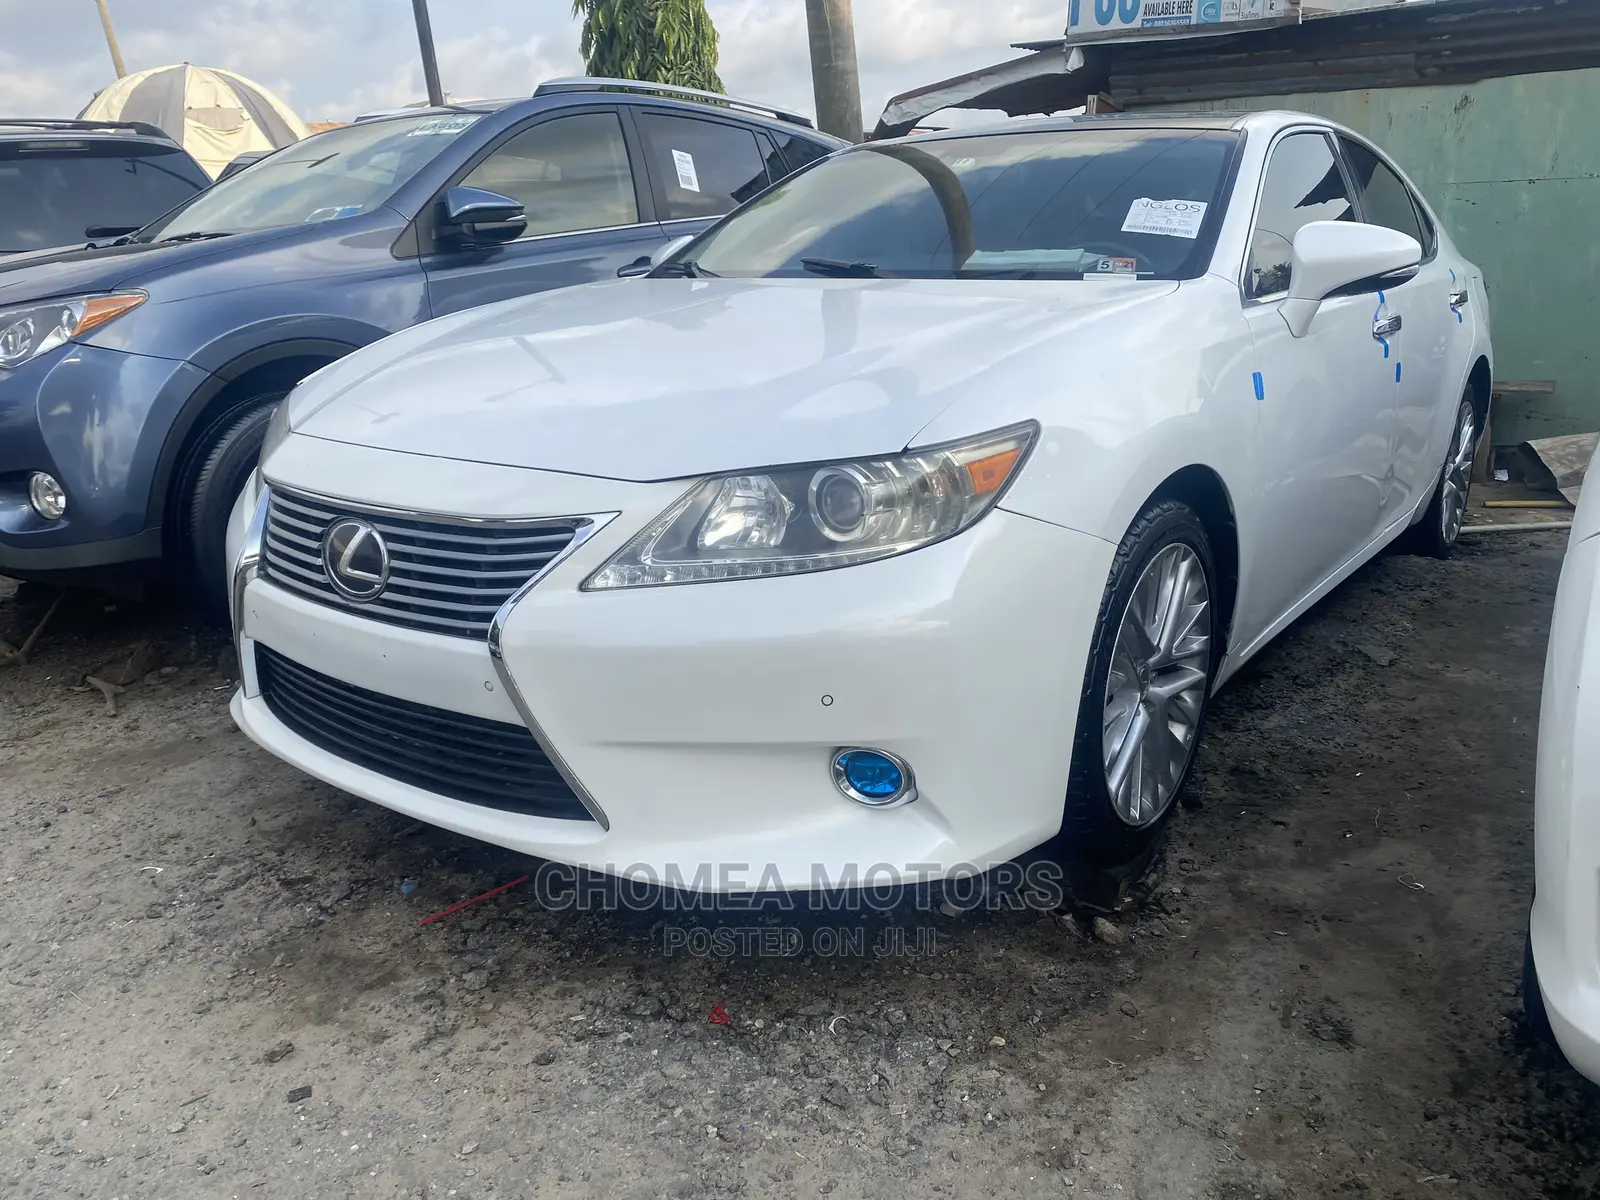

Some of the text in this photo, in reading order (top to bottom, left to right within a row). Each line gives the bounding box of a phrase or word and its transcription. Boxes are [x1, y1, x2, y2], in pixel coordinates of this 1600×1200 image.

[1143, 2, 1175, 17] AVAILABLE
[1176, 0, 1192, 15] HERE
[1101, 260, 1110, 269] 5
